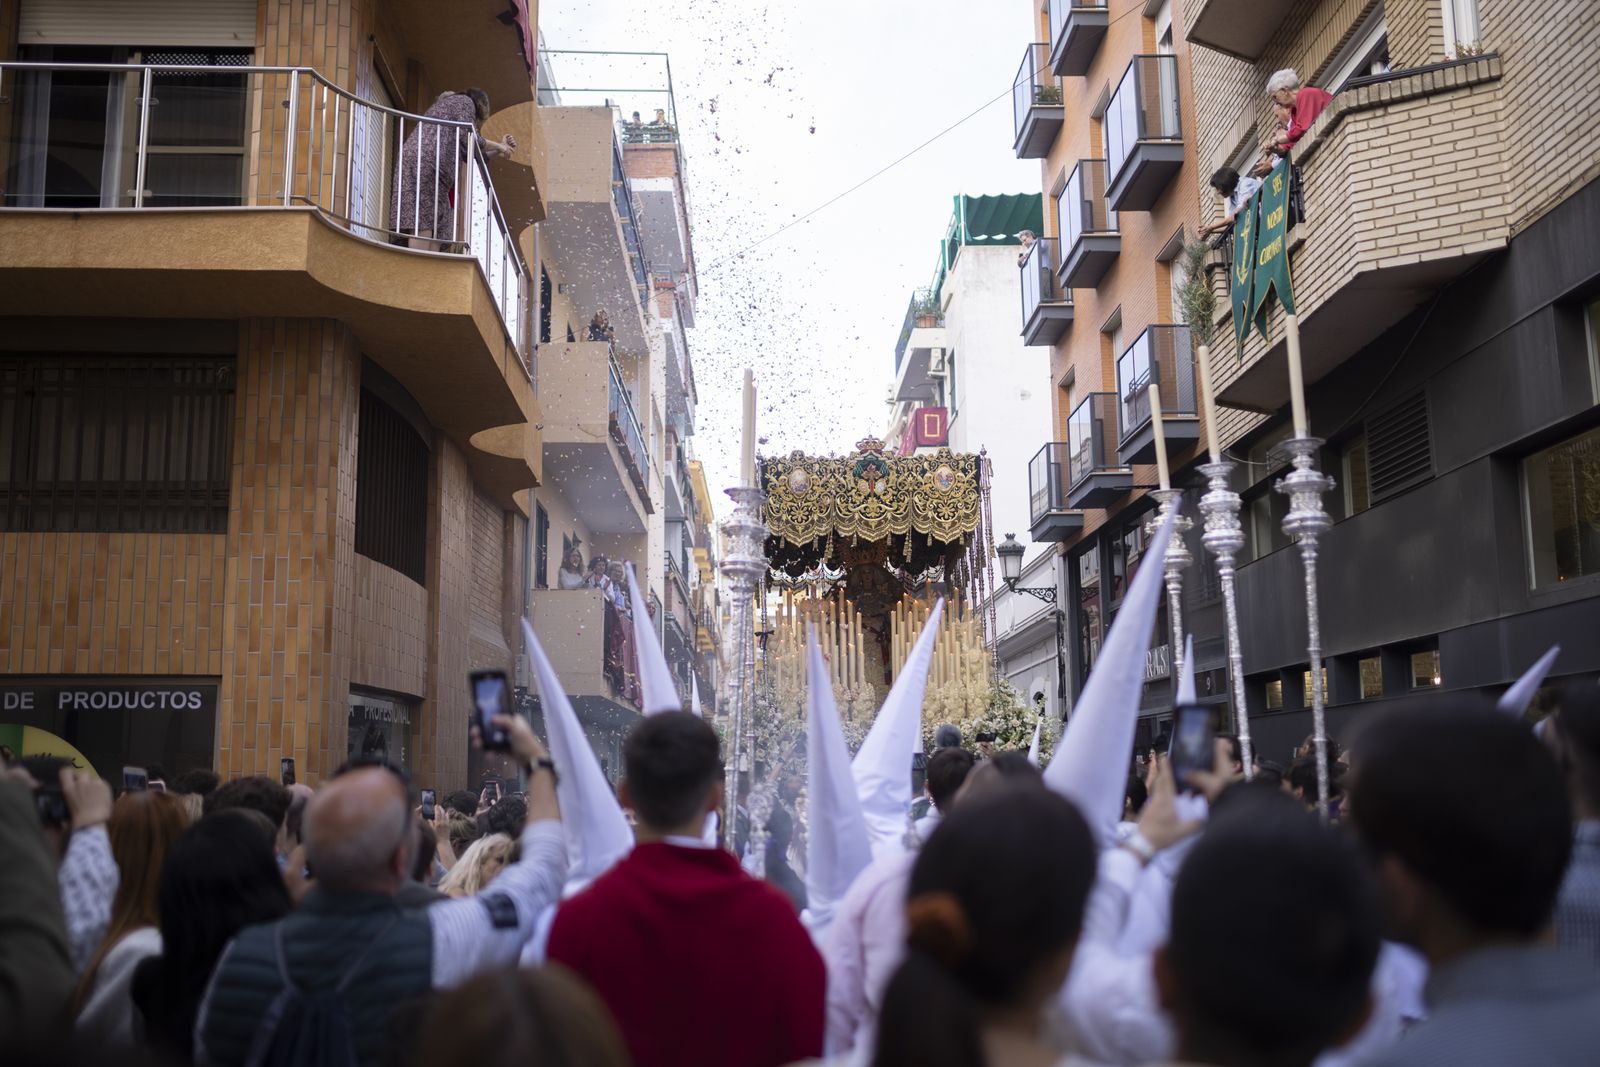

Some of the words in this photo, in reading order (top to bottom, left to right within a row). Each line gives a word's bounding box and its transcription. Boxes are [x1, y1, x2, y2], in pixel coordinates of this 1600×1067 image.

[1206, 676, 1211, 690] 9
[4, 692, 34, 709] DE
[58, 691, 202, 709] PRODUCTOS
[364, 704, 411, 725] PROFESIONAL
